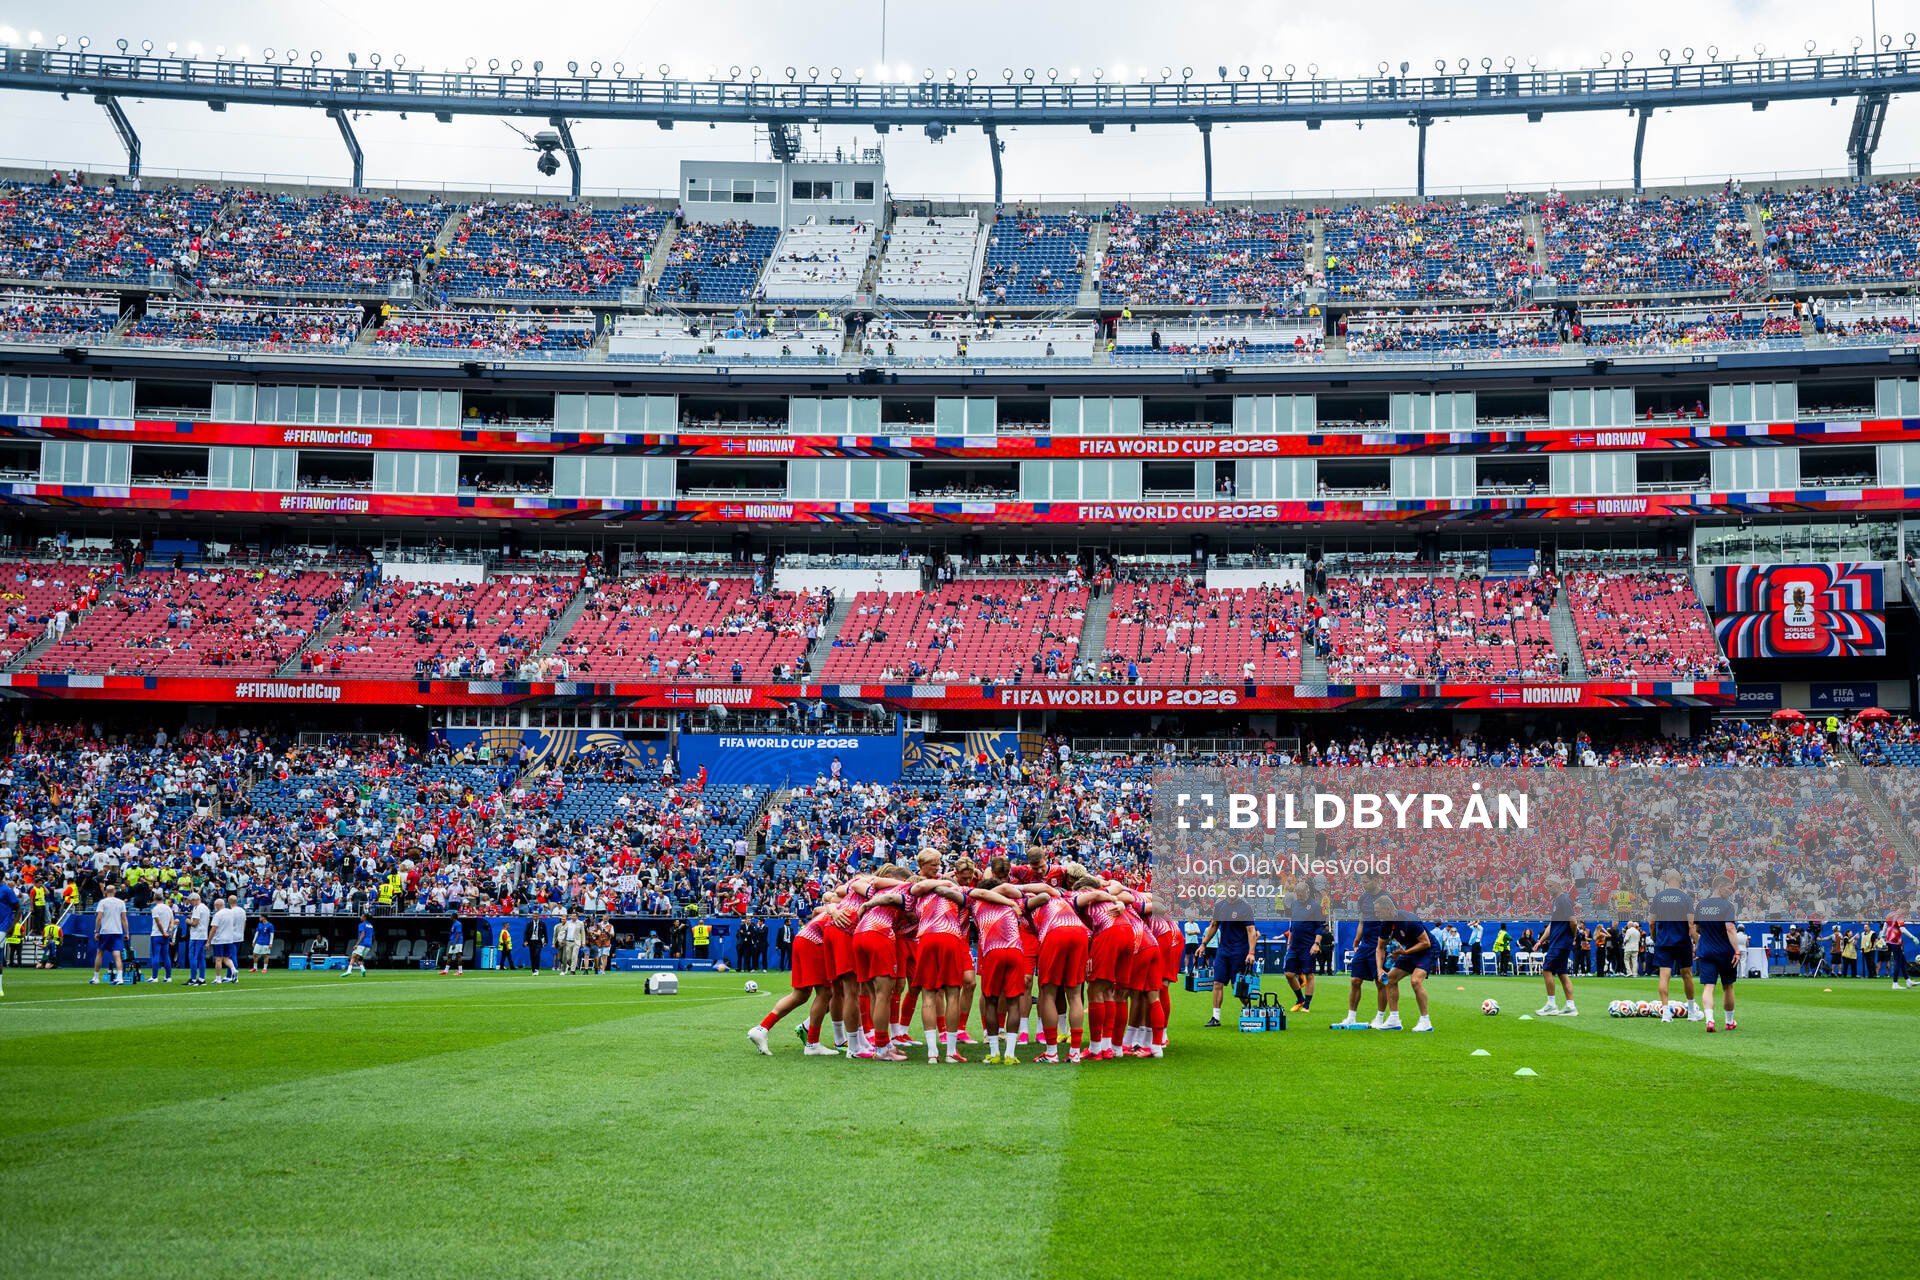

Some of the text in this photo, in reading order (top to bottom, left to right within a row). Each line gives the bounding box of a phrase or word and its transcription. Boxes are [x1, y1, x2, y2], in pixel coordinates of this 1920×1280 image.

[284, 430, 372, 446] #FIFAWorldCup
[1596, 432, 1646, 446] NORWAY
[747, 439, 795, 452] NORWAY
[1080, 440, 1278, 453] FIFA WORLD CUP 2026
[280, 496, 369, 512] #FIFAWorldCup
[1597, 499, 1647, 513] NORWAY
[745, 505, 793, 518] NORWAY
[1078, 505, 1278, 519] FIFA WORLD CUP 2026
[236, 683, 340, 701] #FIFAWorldCup
[696, 689, 752, 704] NORWAY
[1001, 690, 1237, 705] FIFA WORLD CUP 2026
[1523, 688, 1581, 703] NORWAY
[1740, 692, 1774, 701] 2026
[720, 738, 858, 749] FIFA WORLD CUP 2026
